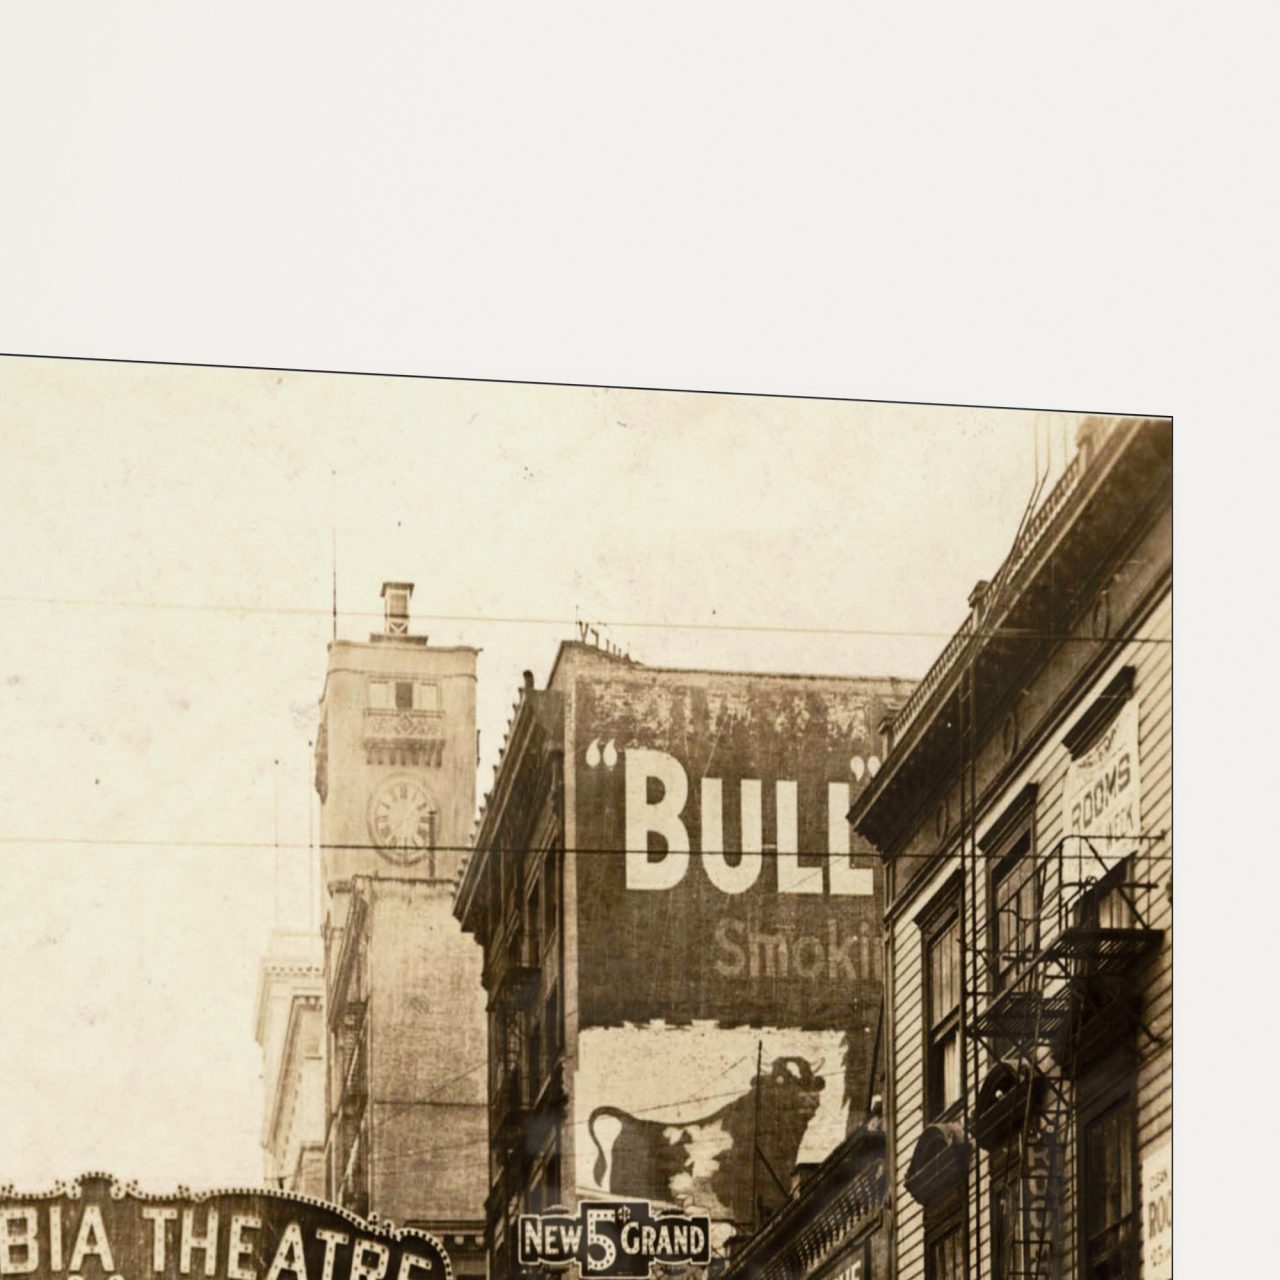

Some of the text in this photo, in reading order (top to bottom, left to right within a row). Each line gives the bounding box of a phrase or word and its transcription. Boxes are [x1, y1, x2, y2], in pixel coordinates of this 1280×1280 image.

[1071, 752, 1131, 838] ROOMS
[524, 1220, 583, 1255] NEW
[620, 1221, 705, 1256] GRAND
